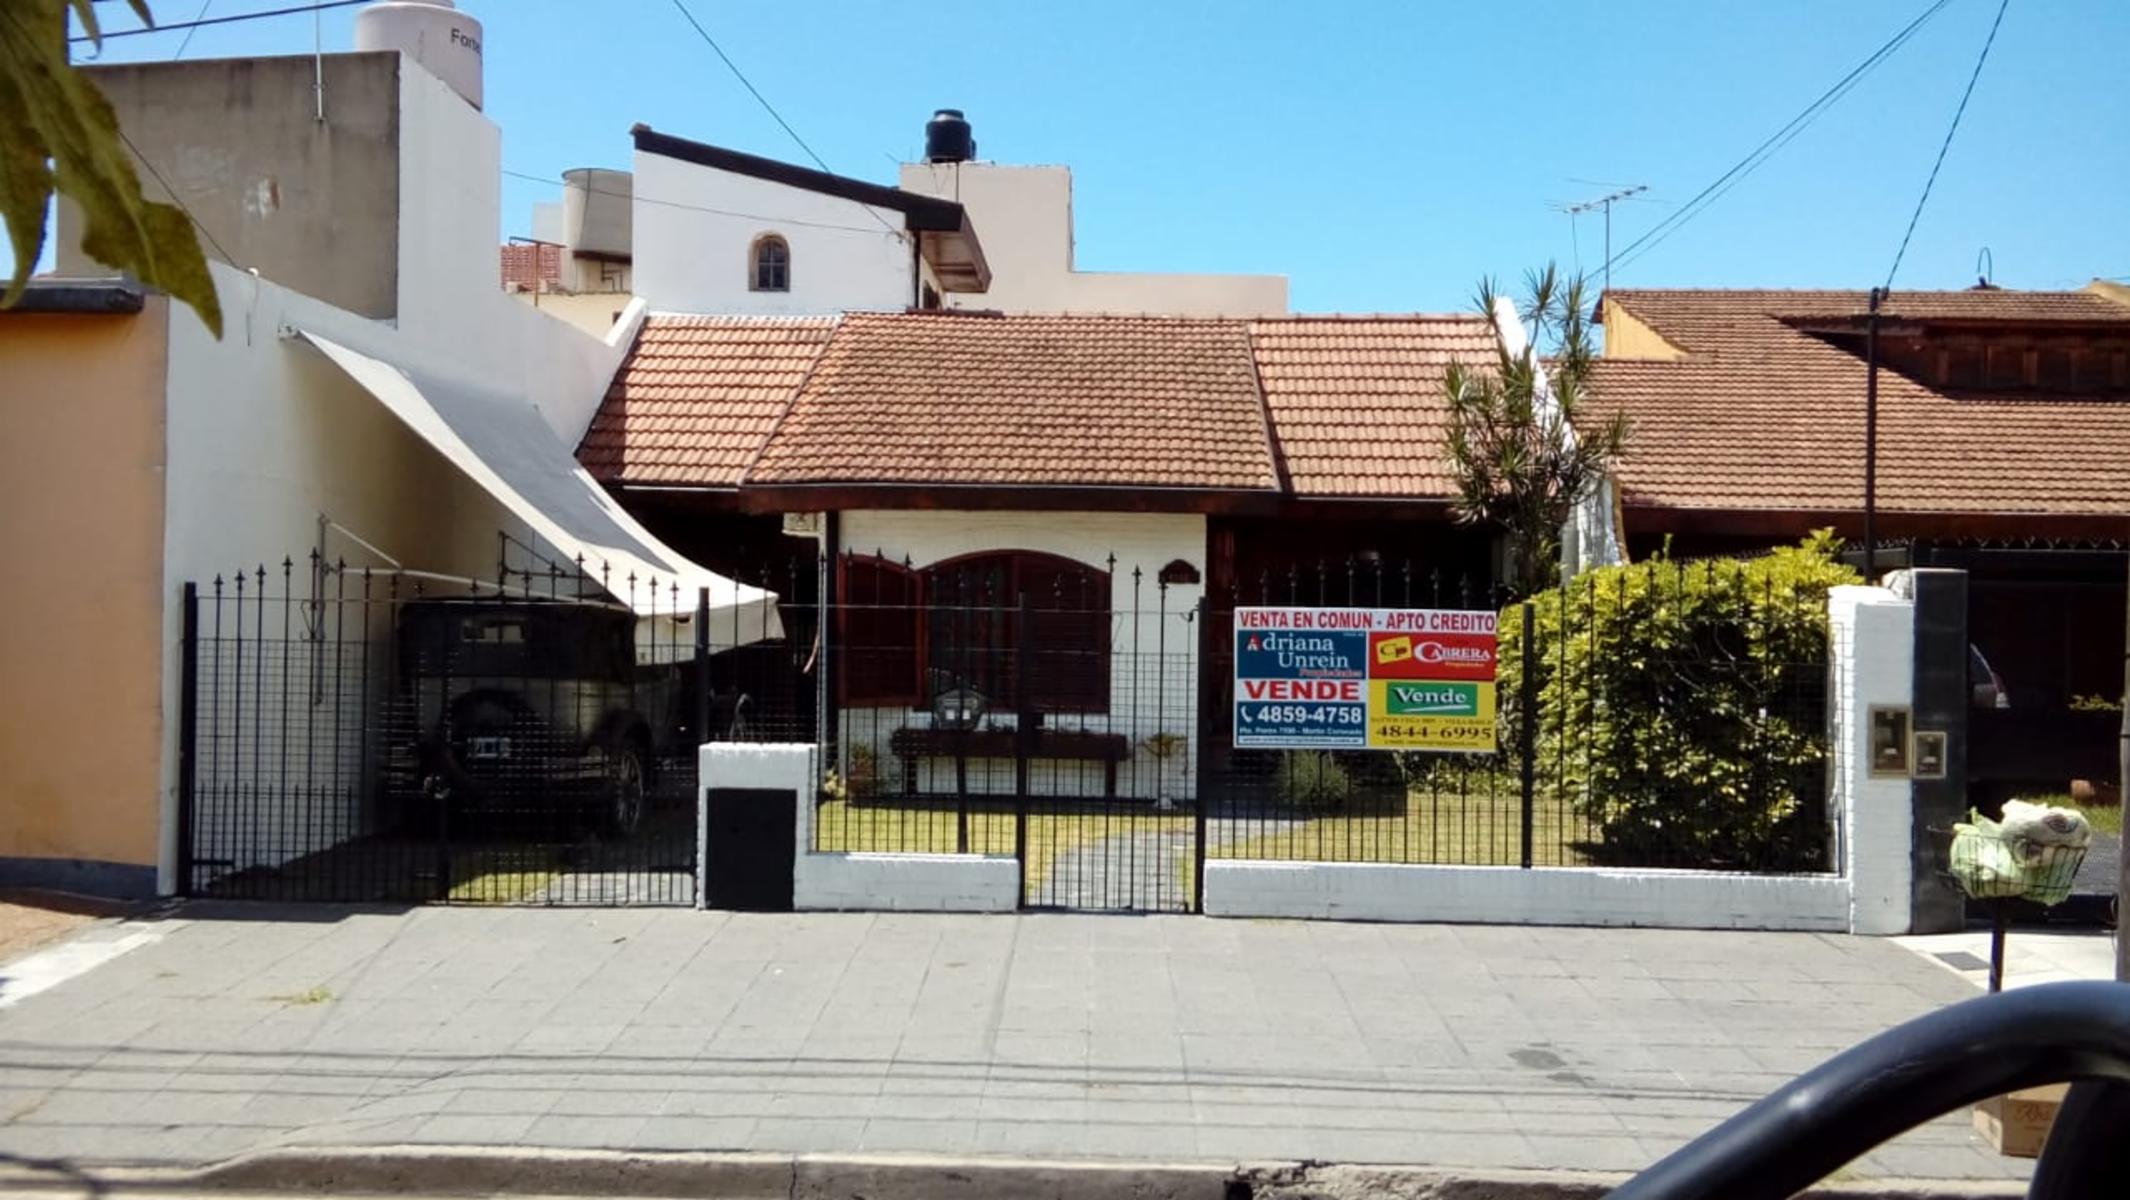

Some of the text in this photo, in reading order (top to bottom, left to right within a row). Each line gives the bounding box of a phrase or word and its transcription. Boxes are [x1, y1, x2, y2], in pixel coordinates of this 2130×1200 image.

[1240, 611, 1288, 627] VENTA
[1293, 611, 1313, 628] EN
[1317, 612, 1372, 629] COMUN
[1386, 612, 1425, 629] APTO
[1430, 613, 1495, 631] CREDITO
[1247, 632, 1334, 651] Adriana
[1278, 651, 1349, 668] Unrein
[1244, 680, 1360, 701] VENDE
[1394, 687, 1467, 704] Vende
[1257, 705, 1362, 723] 4859-4758
[1376, 725, 1493, 741] 4844-6995
